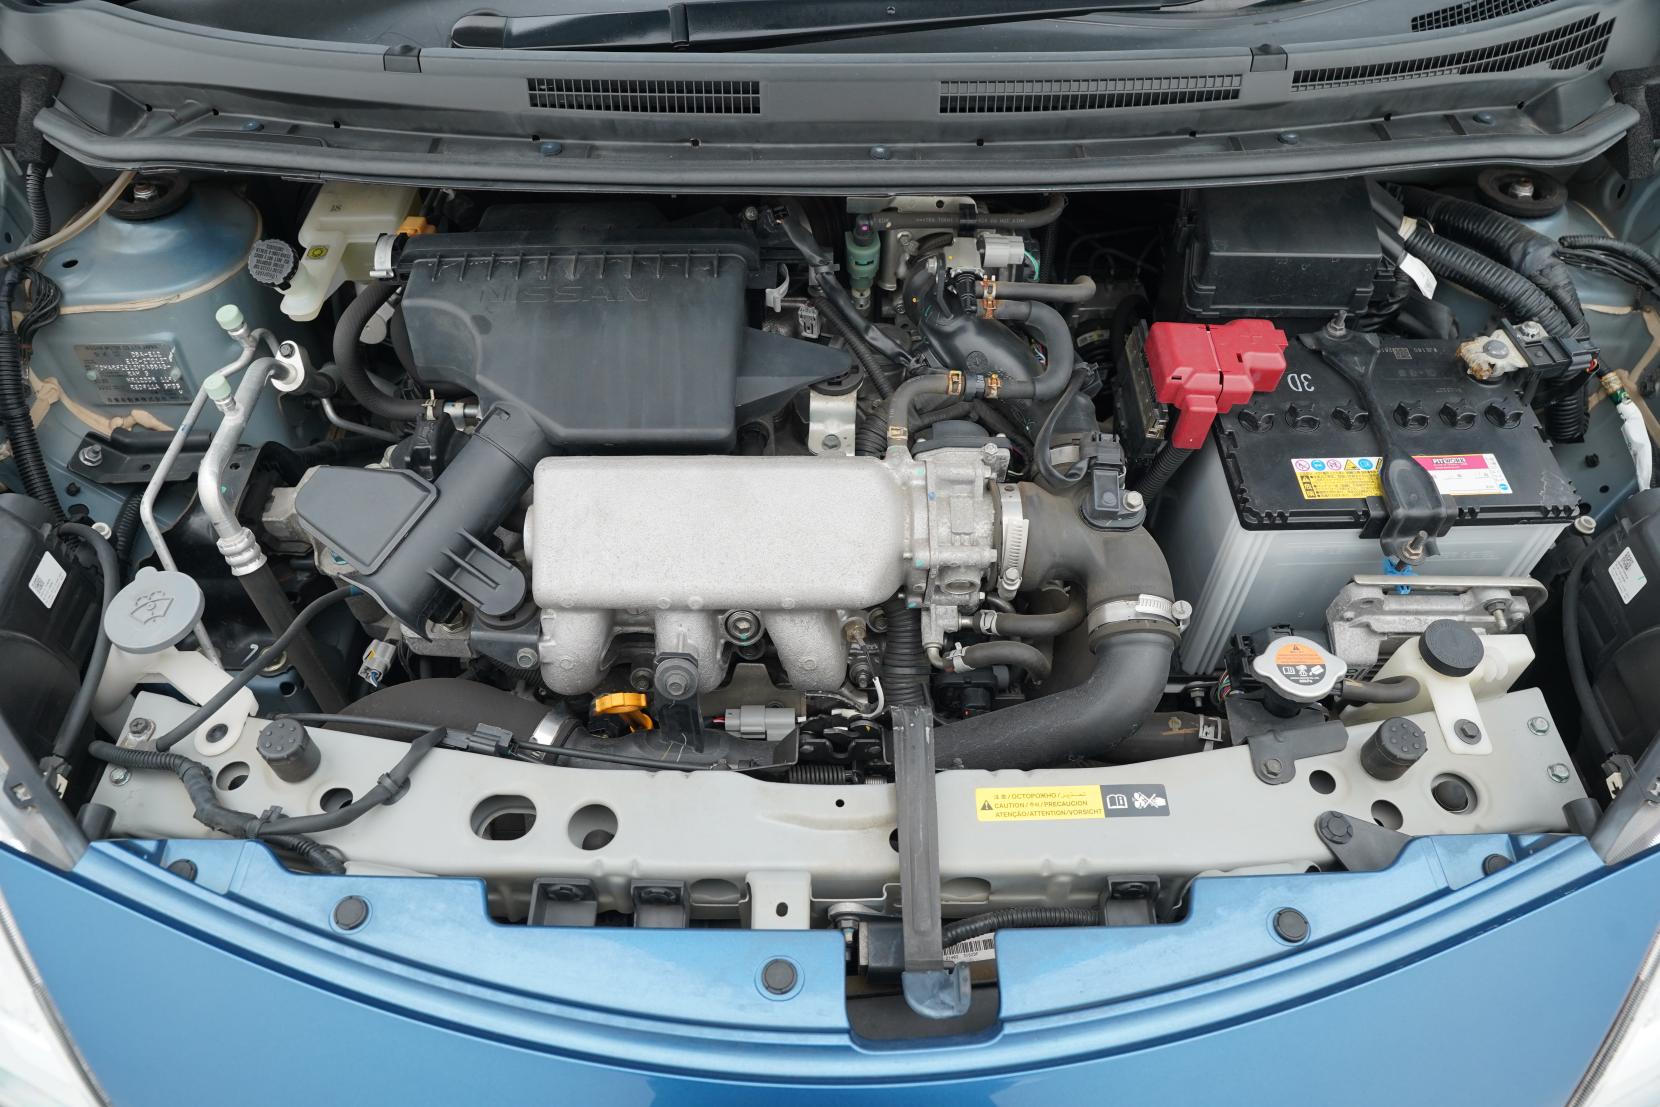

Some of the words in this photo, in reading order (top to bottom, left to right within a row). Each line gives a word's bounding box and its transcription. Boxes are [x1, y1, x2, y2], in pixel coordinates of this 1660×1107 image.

[480, 286, 648, 302] NISSAN
[1287, 373, 1315, 391] 3D
[994, 800, 1025, 809] CAUTION
